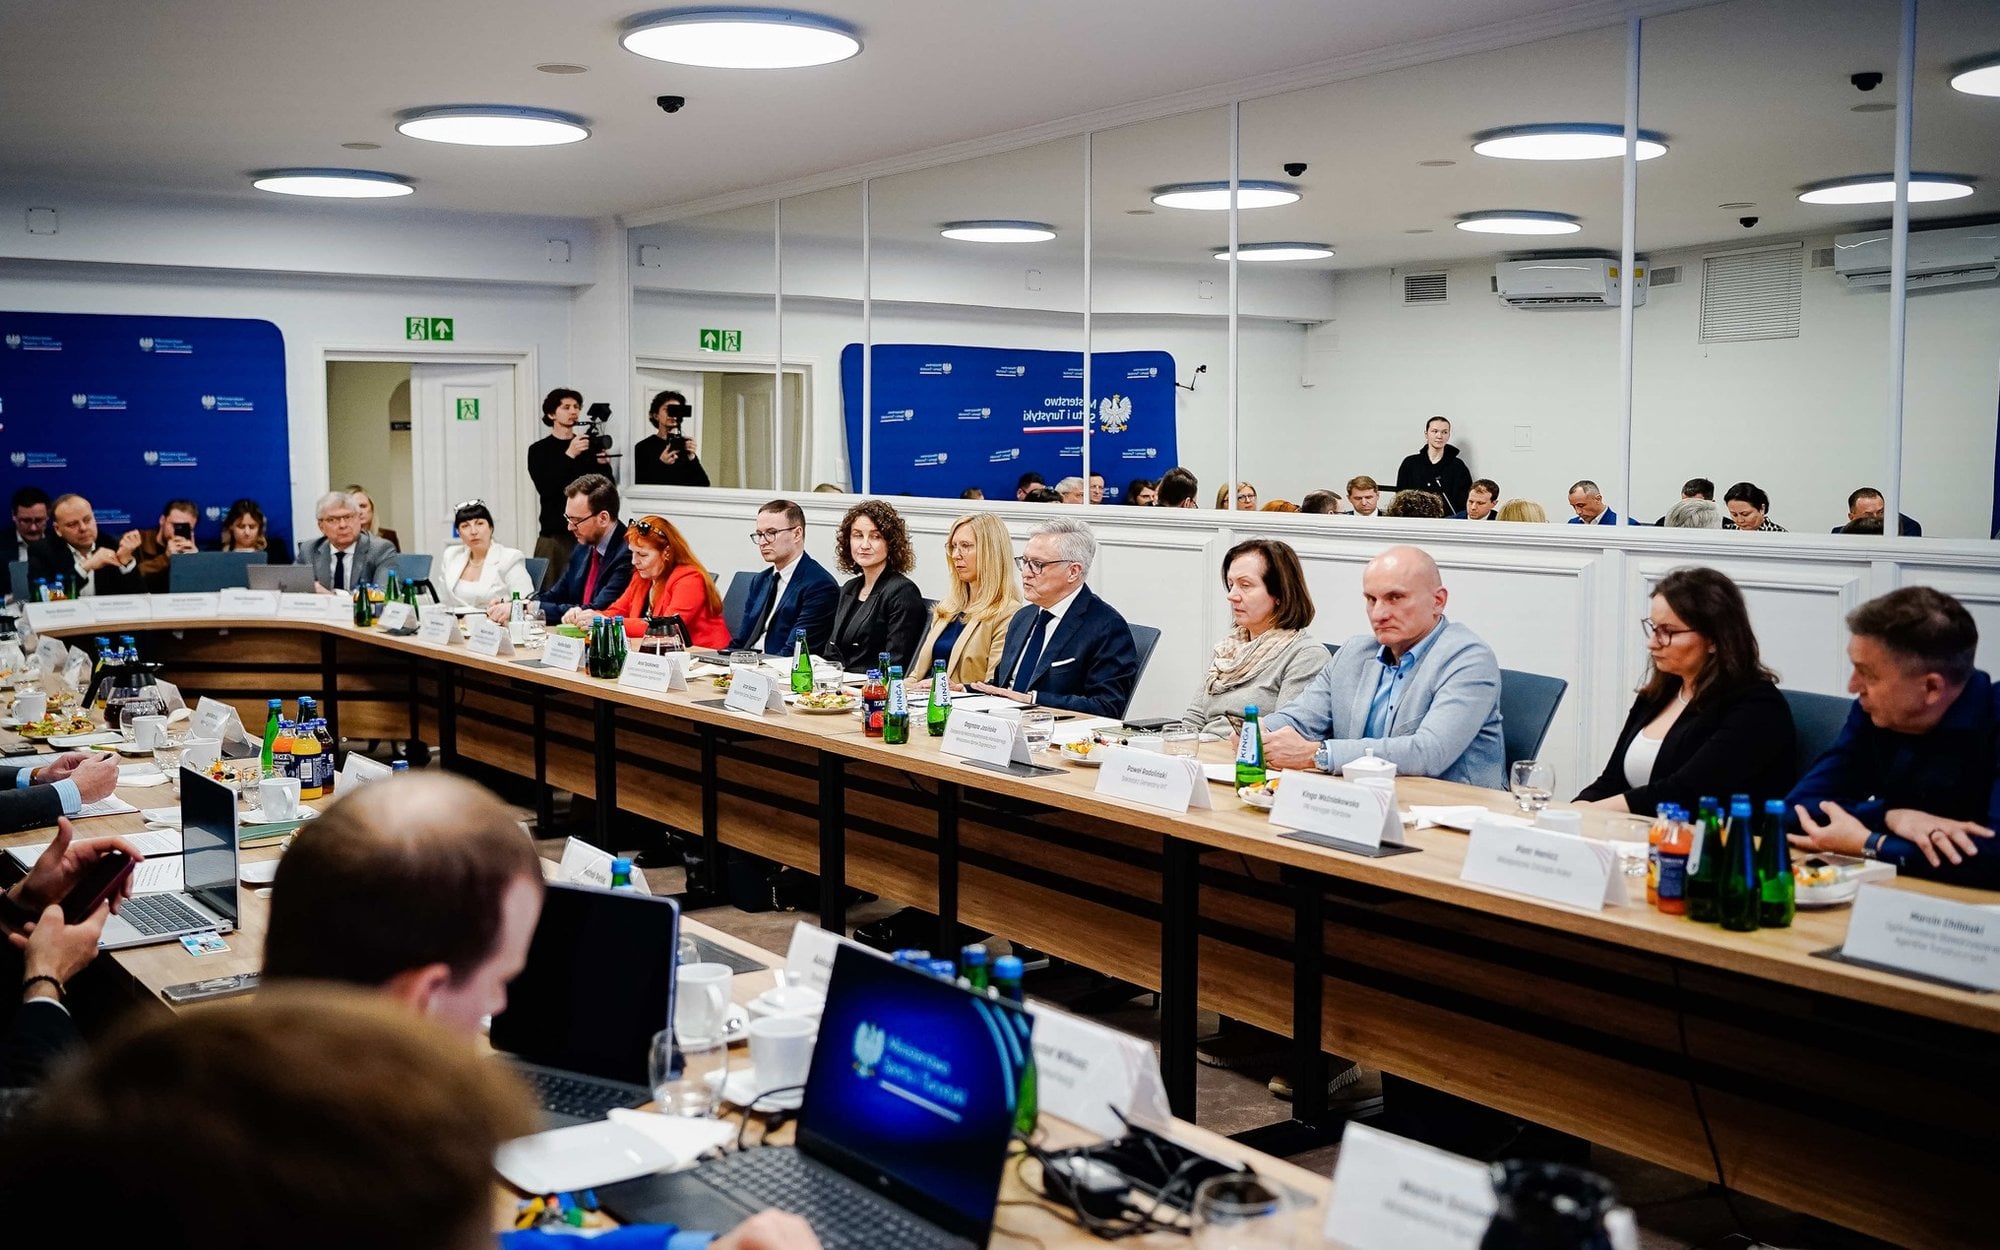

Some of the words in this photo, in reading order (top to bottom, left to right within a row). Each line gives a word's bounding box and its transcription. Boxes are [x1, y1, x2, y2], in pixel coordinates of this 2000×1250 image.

[895, 683, 904, 711] KINGA
[940, 675, 948, 703] KINGA
[1241, 726, 1249, 759] KINGA
